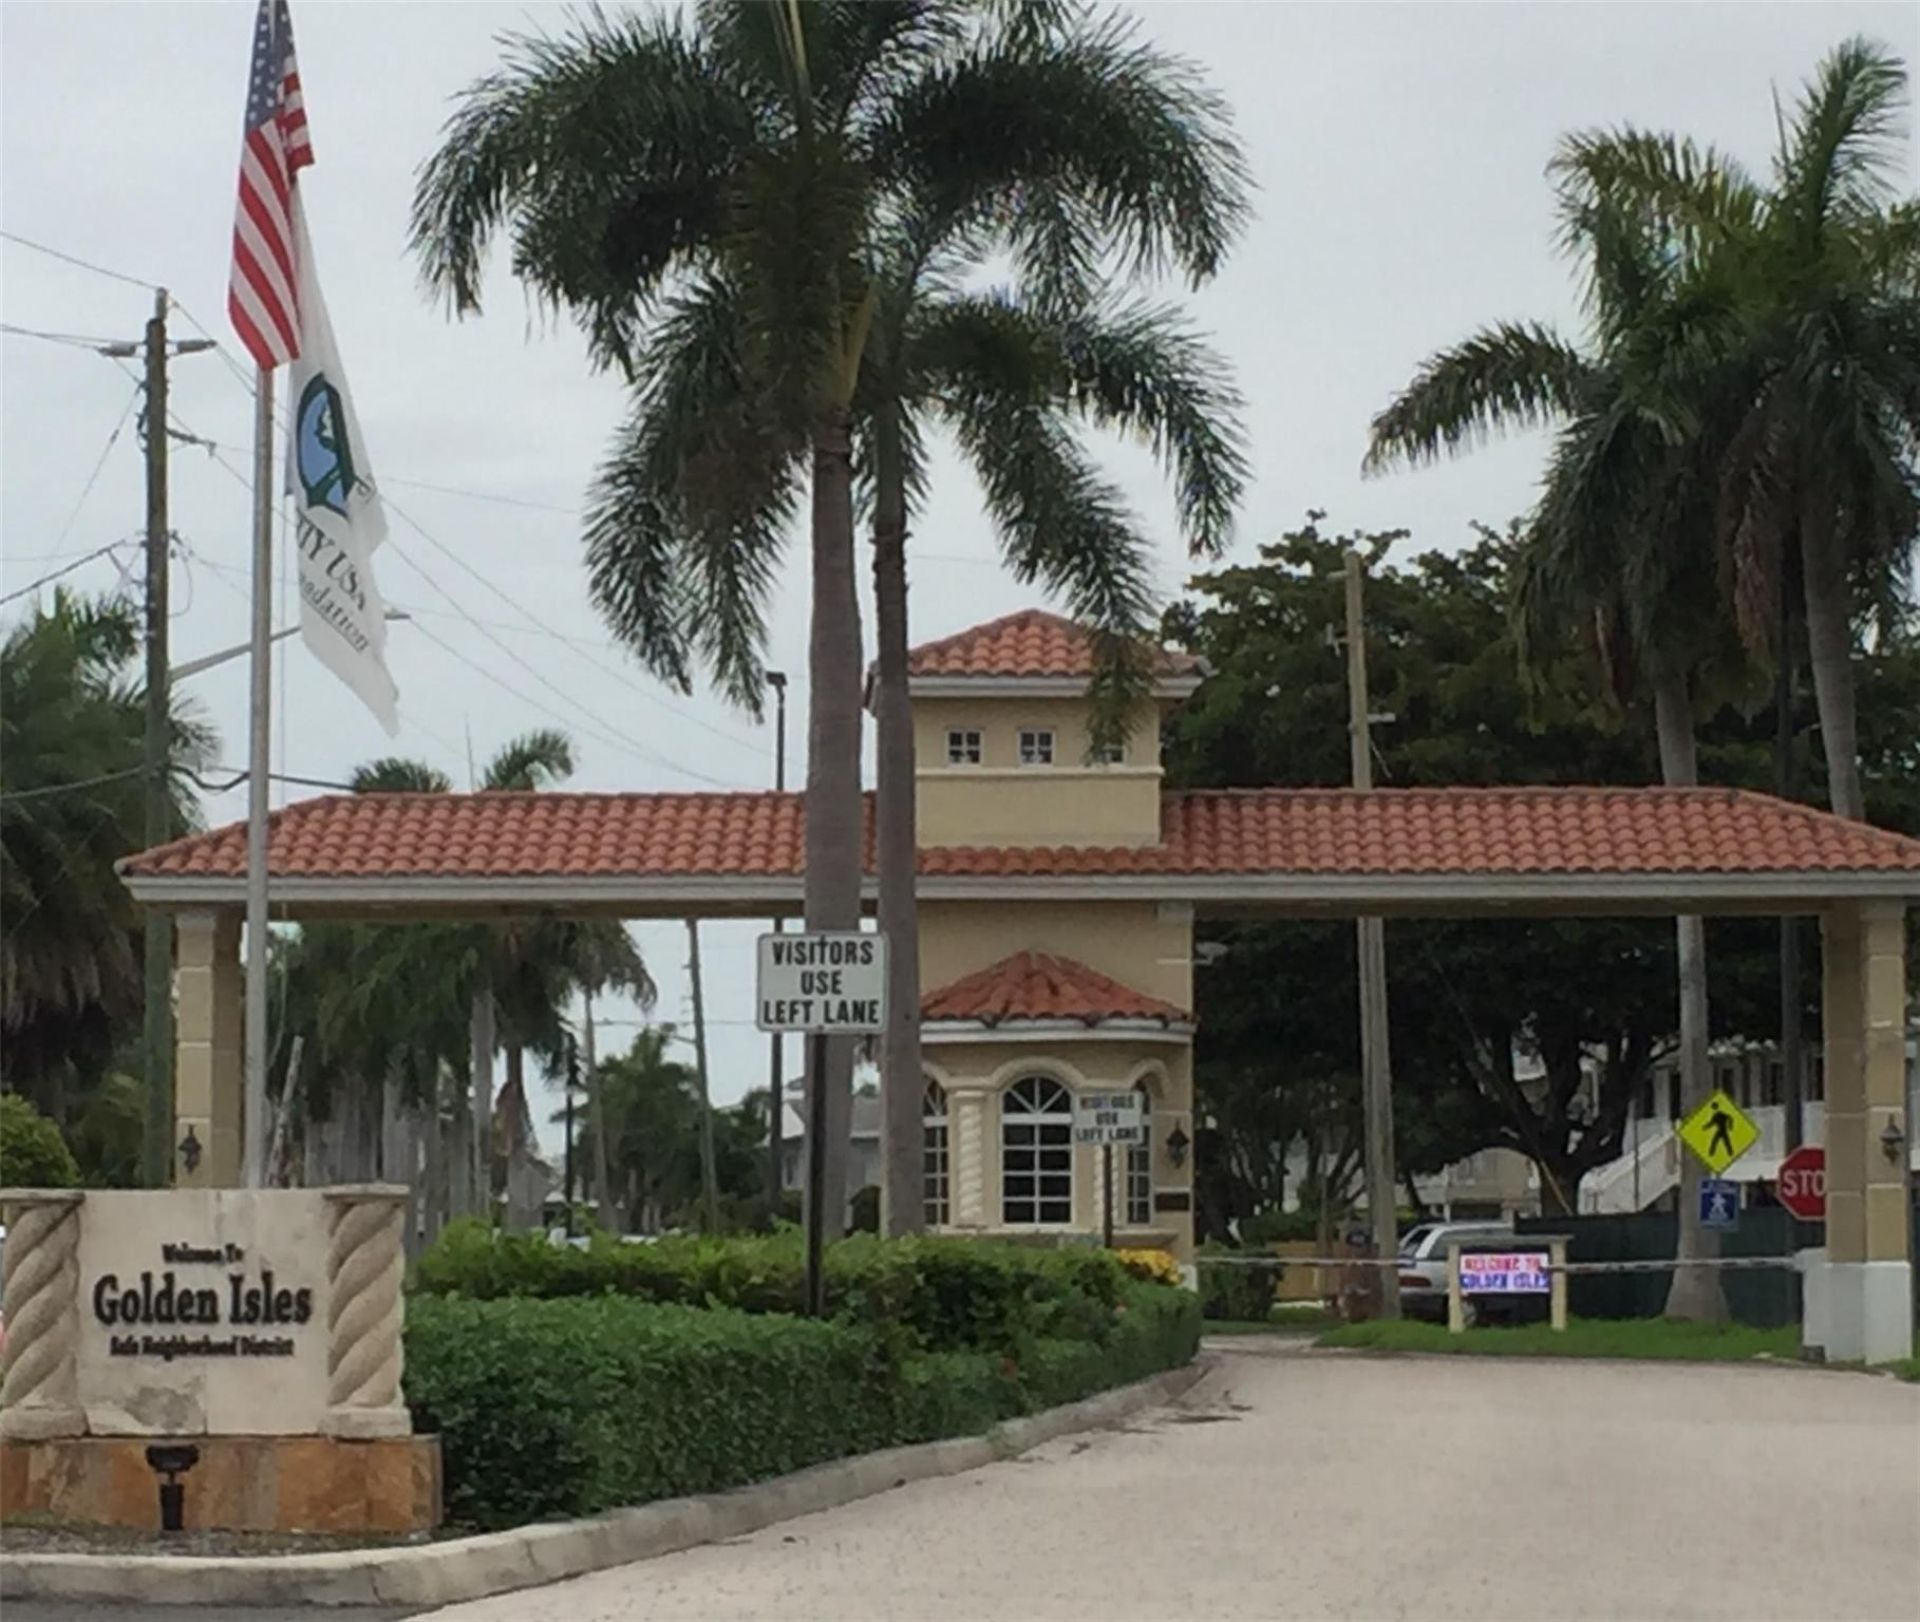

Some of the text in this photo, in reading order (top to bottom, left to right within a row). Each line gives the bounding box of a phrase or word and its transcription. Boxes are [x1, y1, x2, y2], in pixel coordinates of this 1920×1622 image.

[326, 550, 367, 612] USA
[772, 940, 874, 965] VISITORS
[801, 971, 843, 995] USE
[763, 1000, 879, 1024] LEFT LANE
[1783, 1170, 1826, 1197] STO
[93, 1270, 313, 1325] Golden Isles
